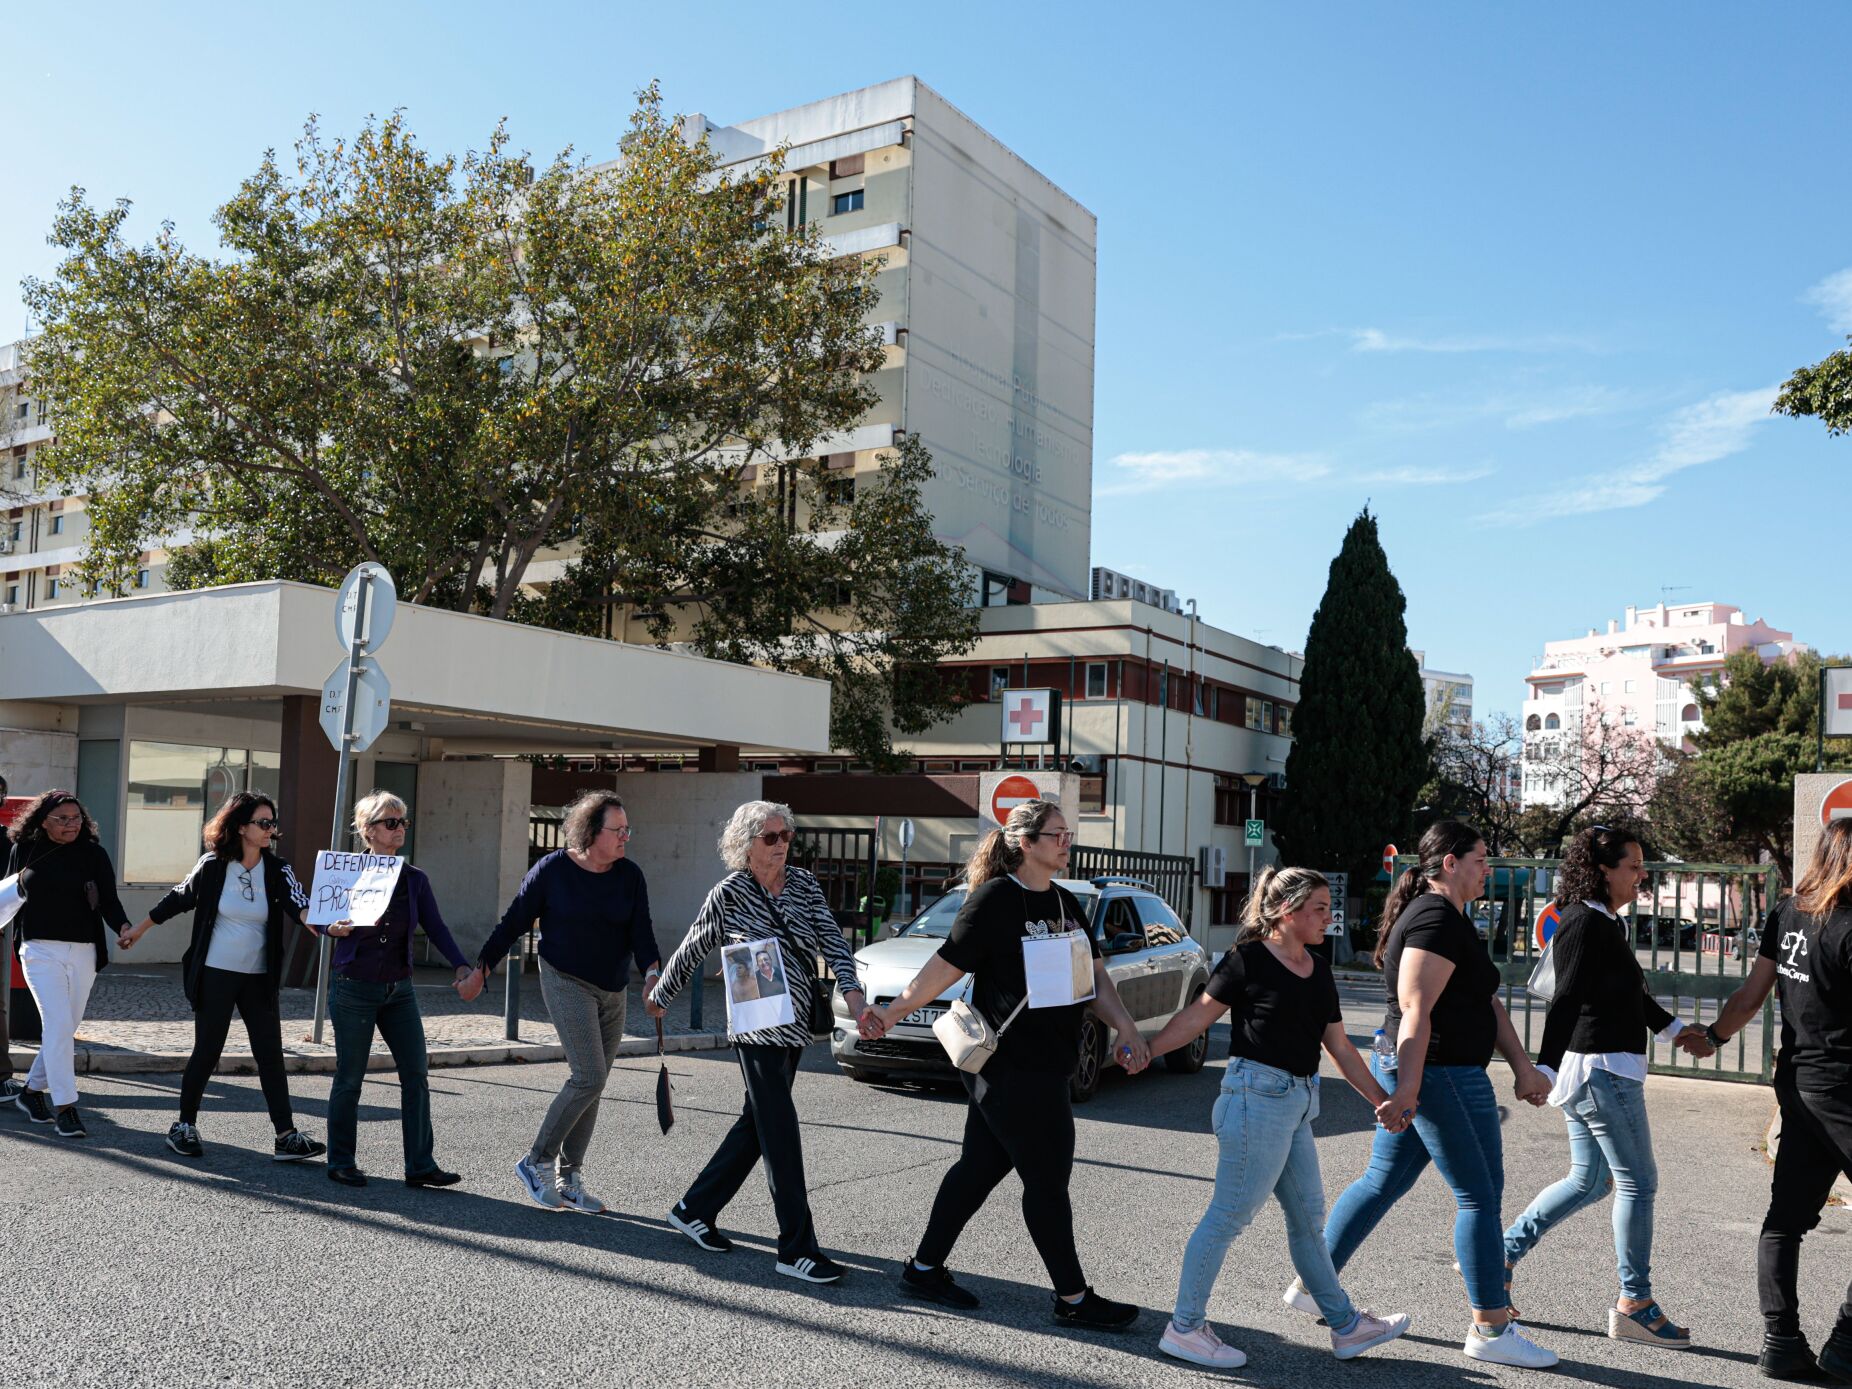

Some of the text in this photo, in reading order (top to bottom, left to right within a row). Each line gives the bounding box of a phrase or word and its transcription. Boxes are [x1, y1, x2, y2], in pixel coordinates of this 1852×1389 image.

[970, 427, 1042, 485] Tecnologia
[959, 463, 1009, 507] Serviço
[1013, 489, 1030, 514] de
[1034, 496, 1070, 530] Todos
[324, 853, 397, 874] DEFENDER
